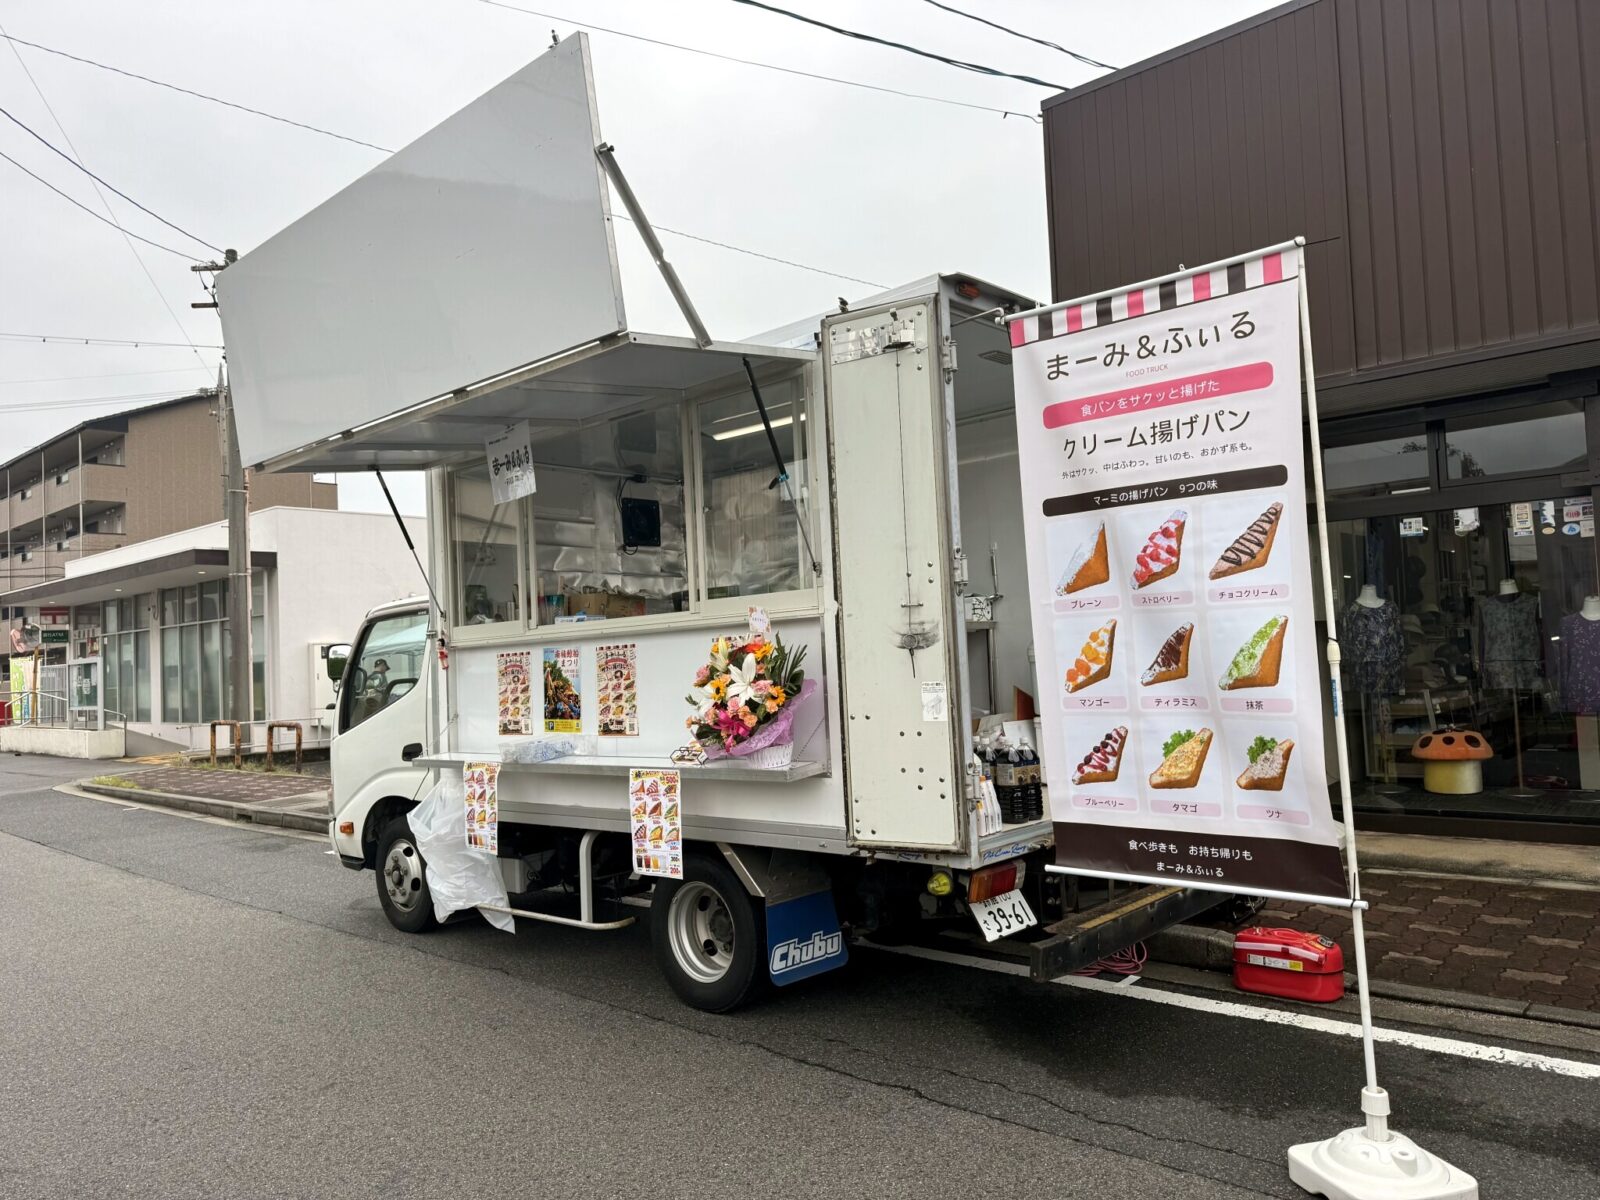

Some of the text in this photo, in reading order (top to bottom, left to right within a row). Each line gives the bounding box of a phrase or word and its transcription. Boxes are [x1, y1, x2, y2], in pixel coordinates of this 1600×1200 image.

[1125, 363, 1169, 378] FOOD TRUCK
[1081, 379, 1220, 417] 食パンをサクッと揚げた
[1063, 410, 1251, 459] クリーム揚げパン
[1093, 480, 1218, 505] マーミの揚げパン 9つの味
[1218, 588, 1278, 600] チョコクリーム
[1070, 599, 1102, 609] プレーン
[1141, 595, 1180, 605] ストロベリー
[561, 659, 578, 668] まつり
[1079, 698, 1110, 707] マンゴー
[1154, 698, 1198, 707] ティラミス
[1245, 700, 1264, 711] 抹茶
[1085, 797, 1125, 808] ブルーベリー
[1172, 802, 1198, 813] タマゴ
[1265, 808, 1282, 819] ツナ
[1128, 839, 1253, 861] 食べ歩きも お持ち帰りも
[988, 901, 1031, 932] 39-61
[771, 932, 841, 973] Chubu
